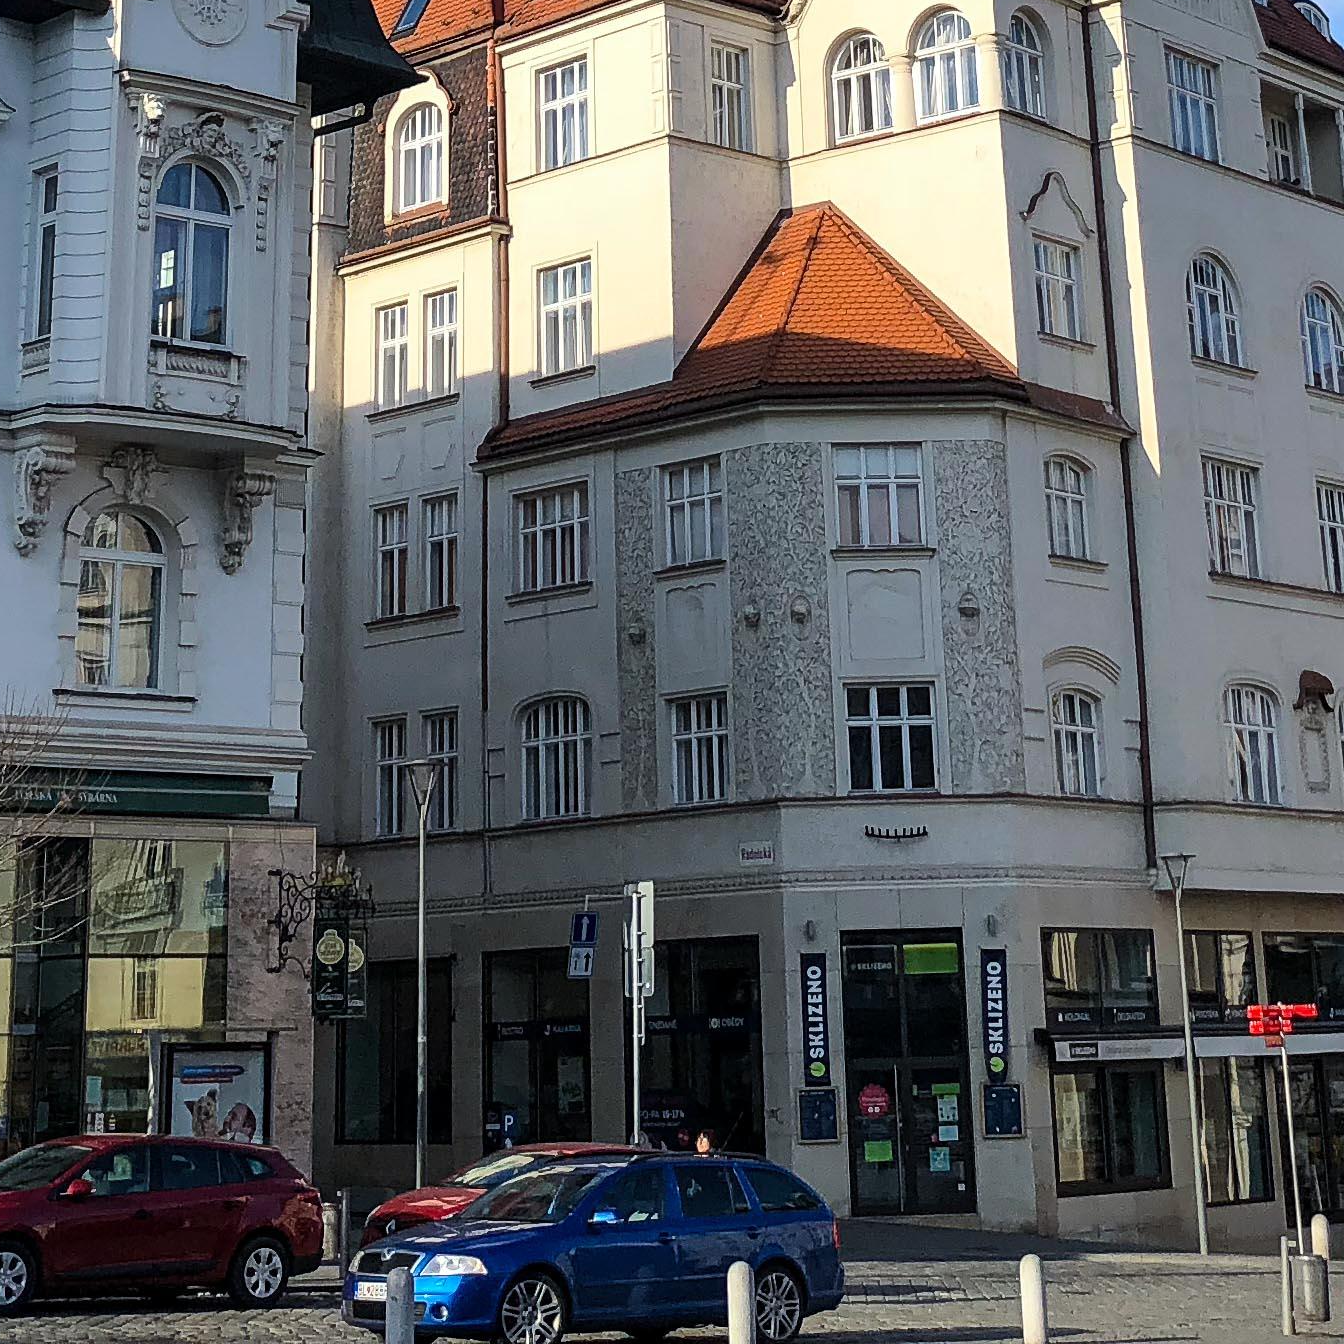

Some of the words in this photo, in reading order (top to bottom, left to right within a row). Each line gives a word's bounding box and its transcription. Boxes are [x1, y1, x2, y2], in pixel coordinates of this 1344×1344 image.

[806, 964, 825, 1059] SKLIZENO
[986, 960, 1004, 1054] SKLIZENO
[504, 1114, 514, 1132] P
